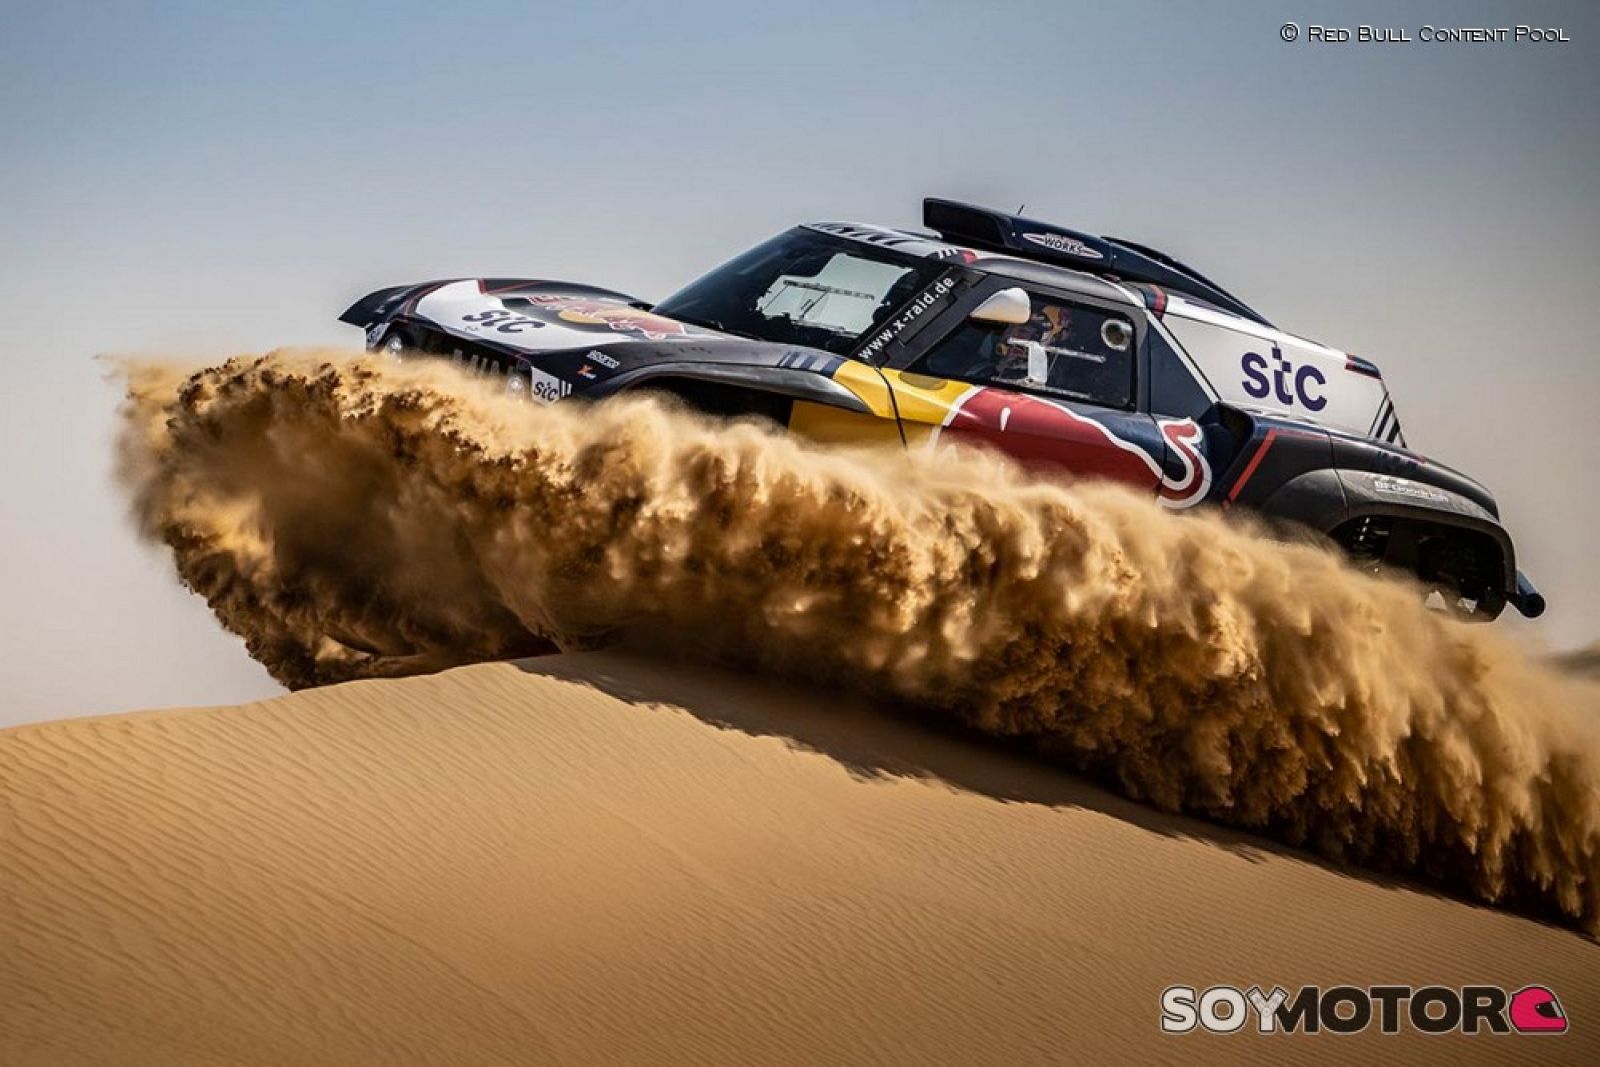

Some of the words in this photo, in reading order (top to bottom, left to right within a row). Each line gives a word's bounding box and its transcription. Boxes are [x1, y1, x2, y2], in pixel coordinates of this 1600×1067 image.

[1045, 236, 1083, 255] WORKS
[461, 309, 546, 334] stc
[858, 277, 955, 359] www.x-raid.de
[533, 381, 559, 402] stc
[1241, 346, 1328, 412] stc
